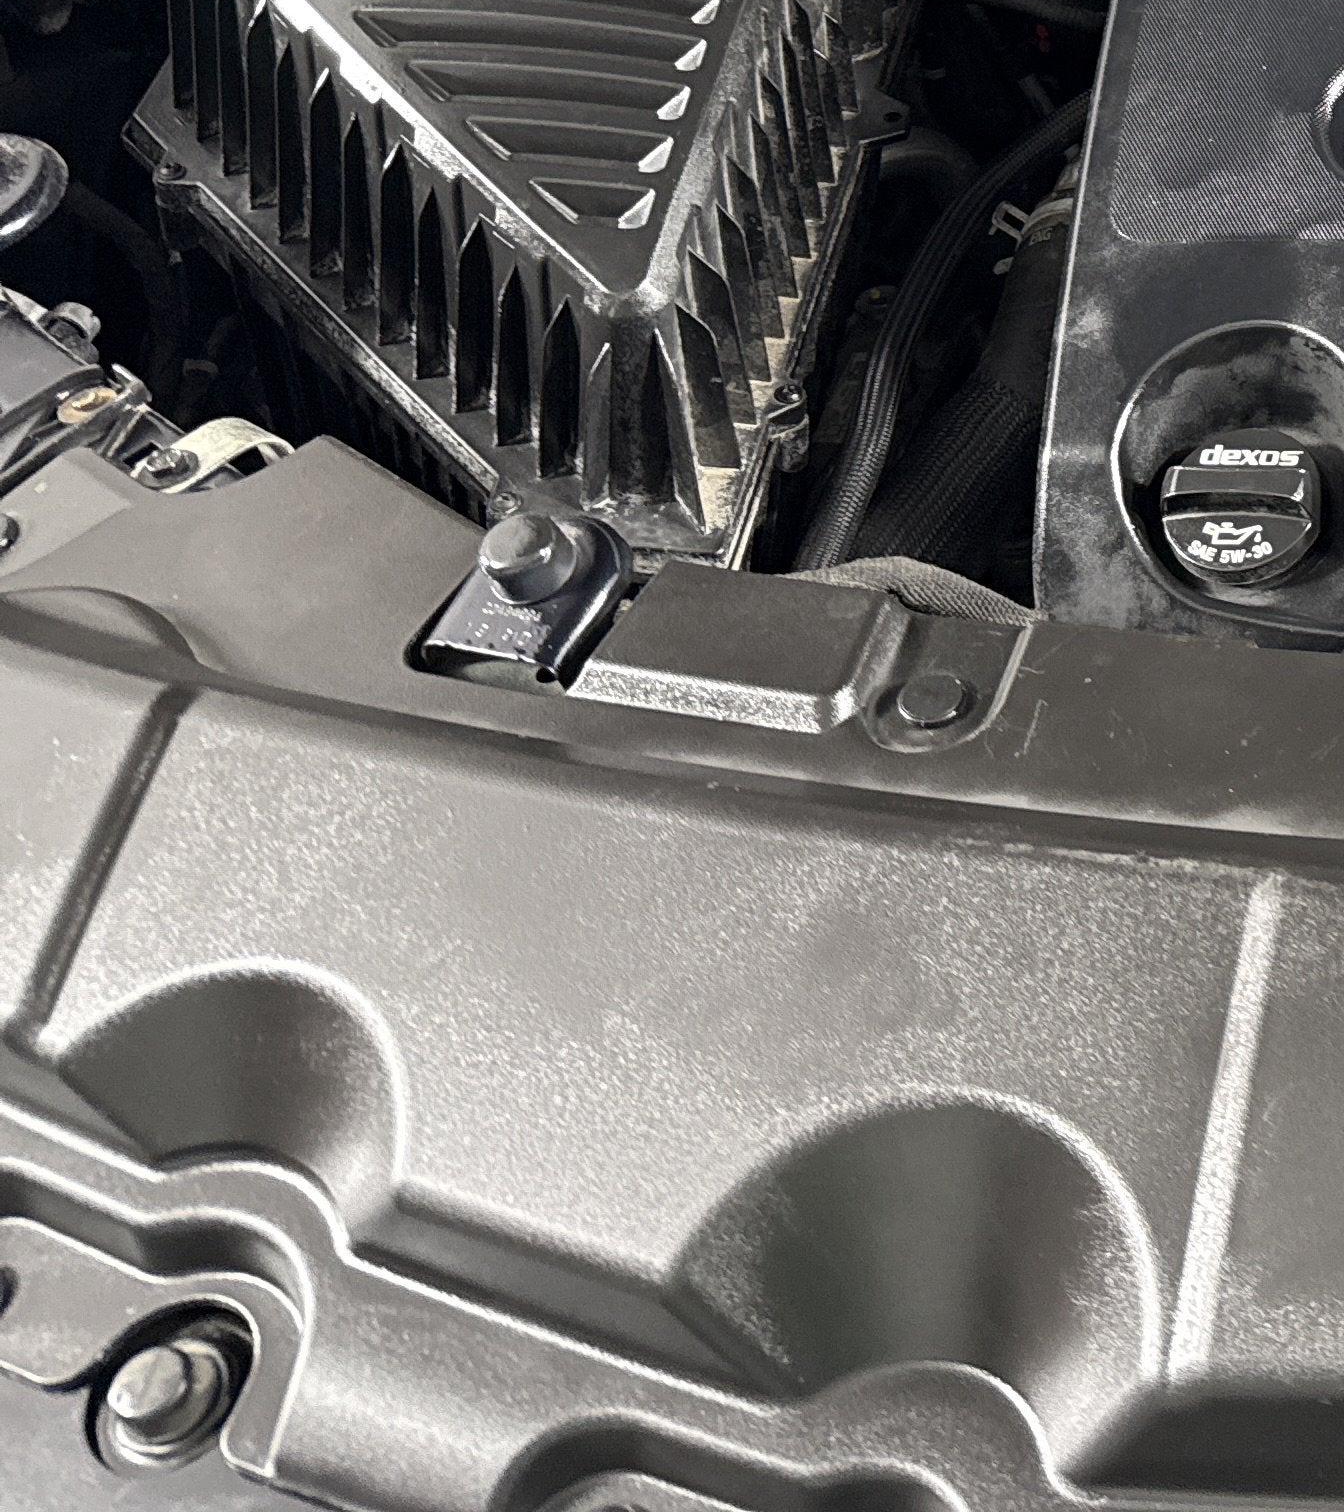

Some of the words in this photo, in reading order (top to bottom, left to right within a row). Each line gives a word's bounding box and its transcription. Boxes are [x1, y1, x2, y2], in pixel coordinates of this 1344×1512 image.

[1199, 444, 1304, 466] dexos
[1187, 539, 1218, 563] SAE
[1219, 541, 1273, 564] 5W-30
